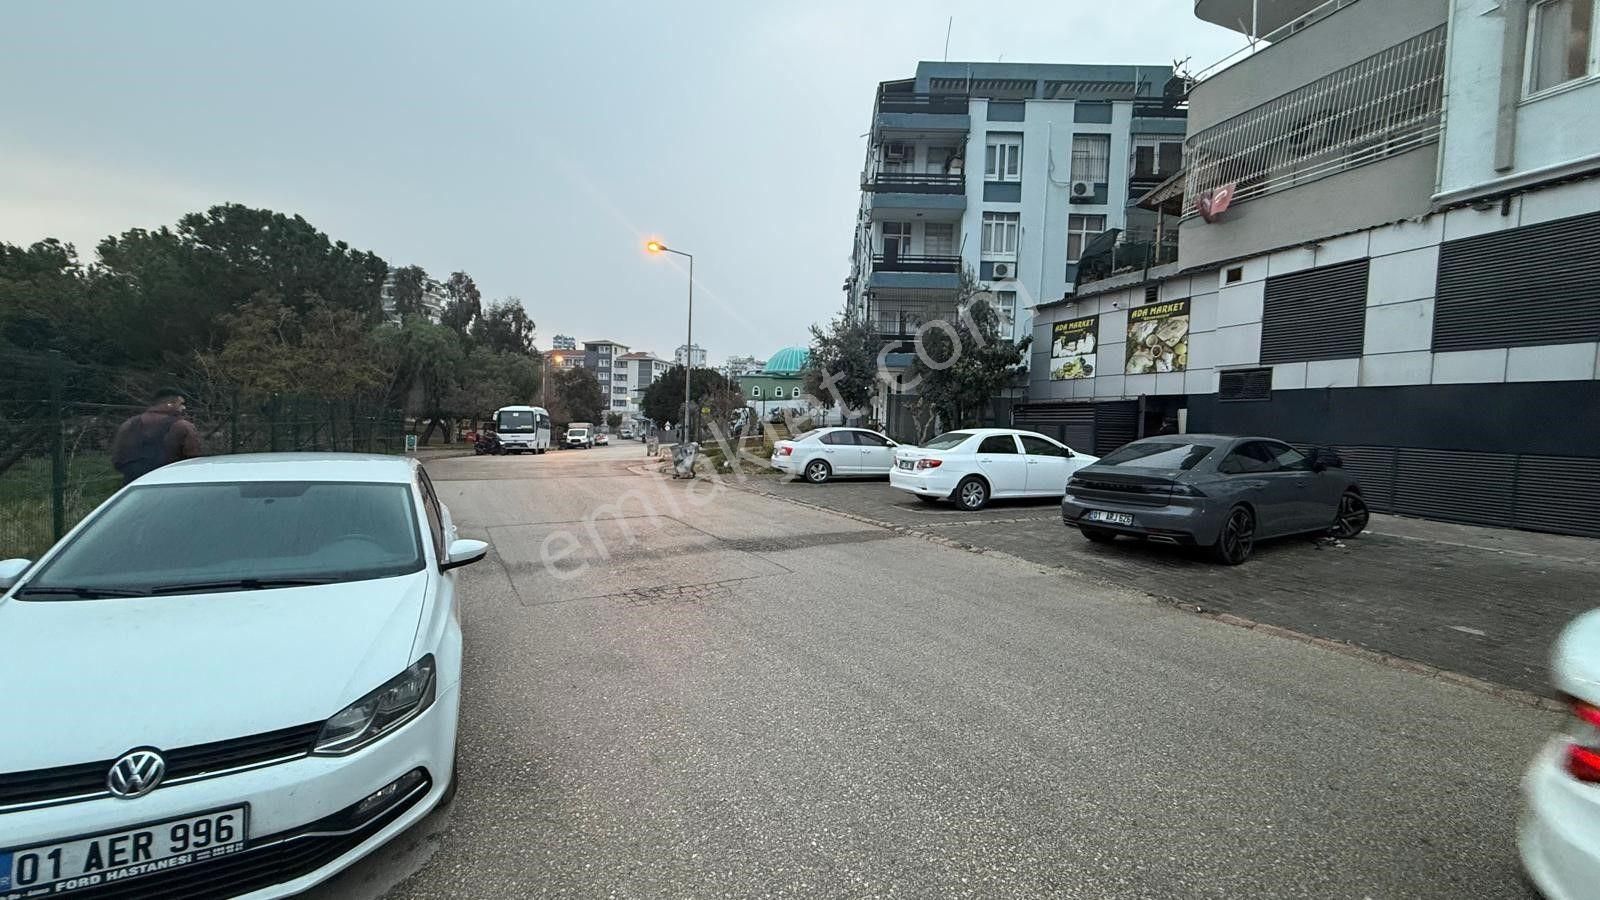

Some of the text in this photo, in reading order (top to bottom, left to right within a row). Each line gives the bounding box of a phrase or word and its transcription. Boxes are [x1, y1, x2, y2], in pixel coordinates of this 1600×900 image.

[1132, 308, 1148, 319] ADA
[1149, 302, 1185, 316] MARKET
[1055, 324, 1068, 332] ADA
[1069, 319, 1095, 330] MARKET
[16, 848, 62, 886] 01
[83, 831, 153, 873] AER
[170, 814, 234, 853] 996
[55, 874, 101, 893] FORD
